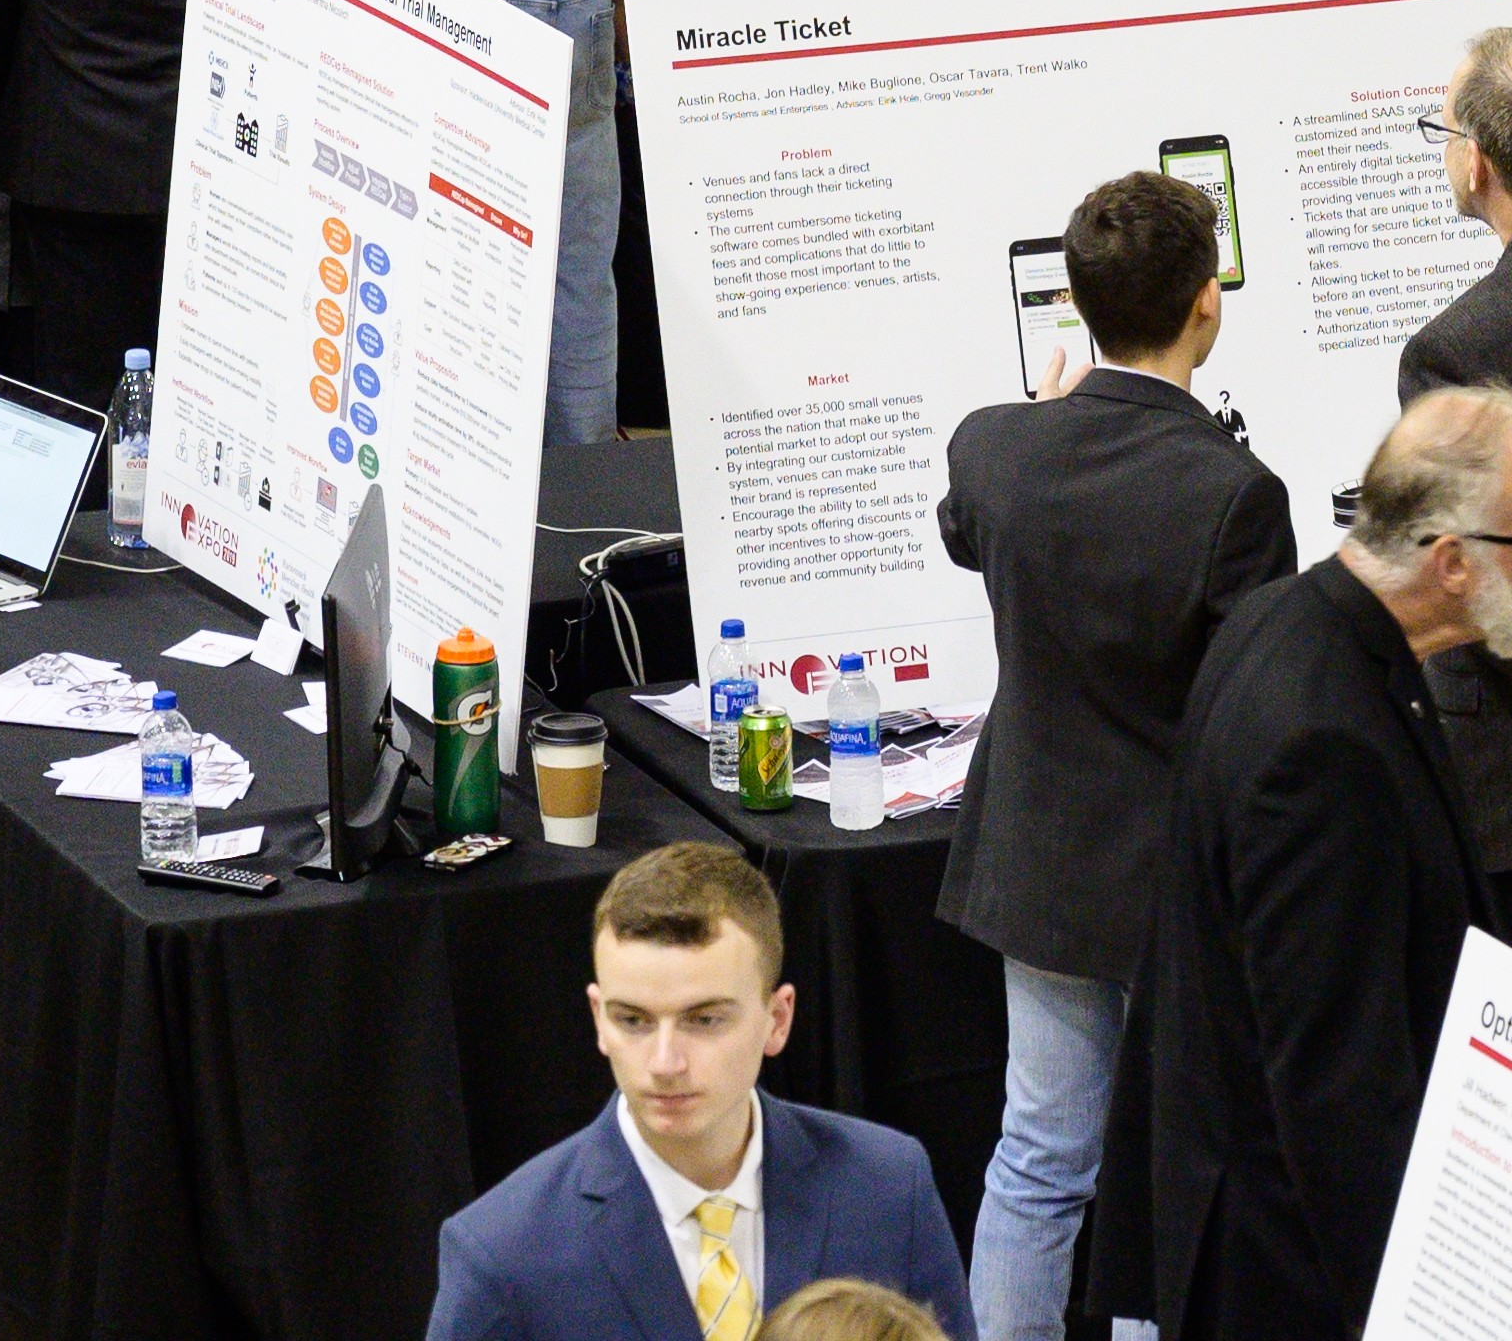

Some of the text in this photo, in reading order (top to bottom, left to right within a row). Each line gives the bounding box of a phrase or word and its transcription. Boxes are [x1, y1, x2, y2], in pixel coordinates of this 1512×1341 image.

[427, 2, 492, 56] Management
[676, 16, 852, 51] Miracle Ticket
[677, 59, 1088, 107] Austin Rocha, Jon Hadley, Mike Buglione, Oscar Tavara, Trent Walko
[781, 148, 832, 161] Problem
[702, 162, 870, 187] Venues and fans lack a direct
[808, 373, 849, 386] Market
